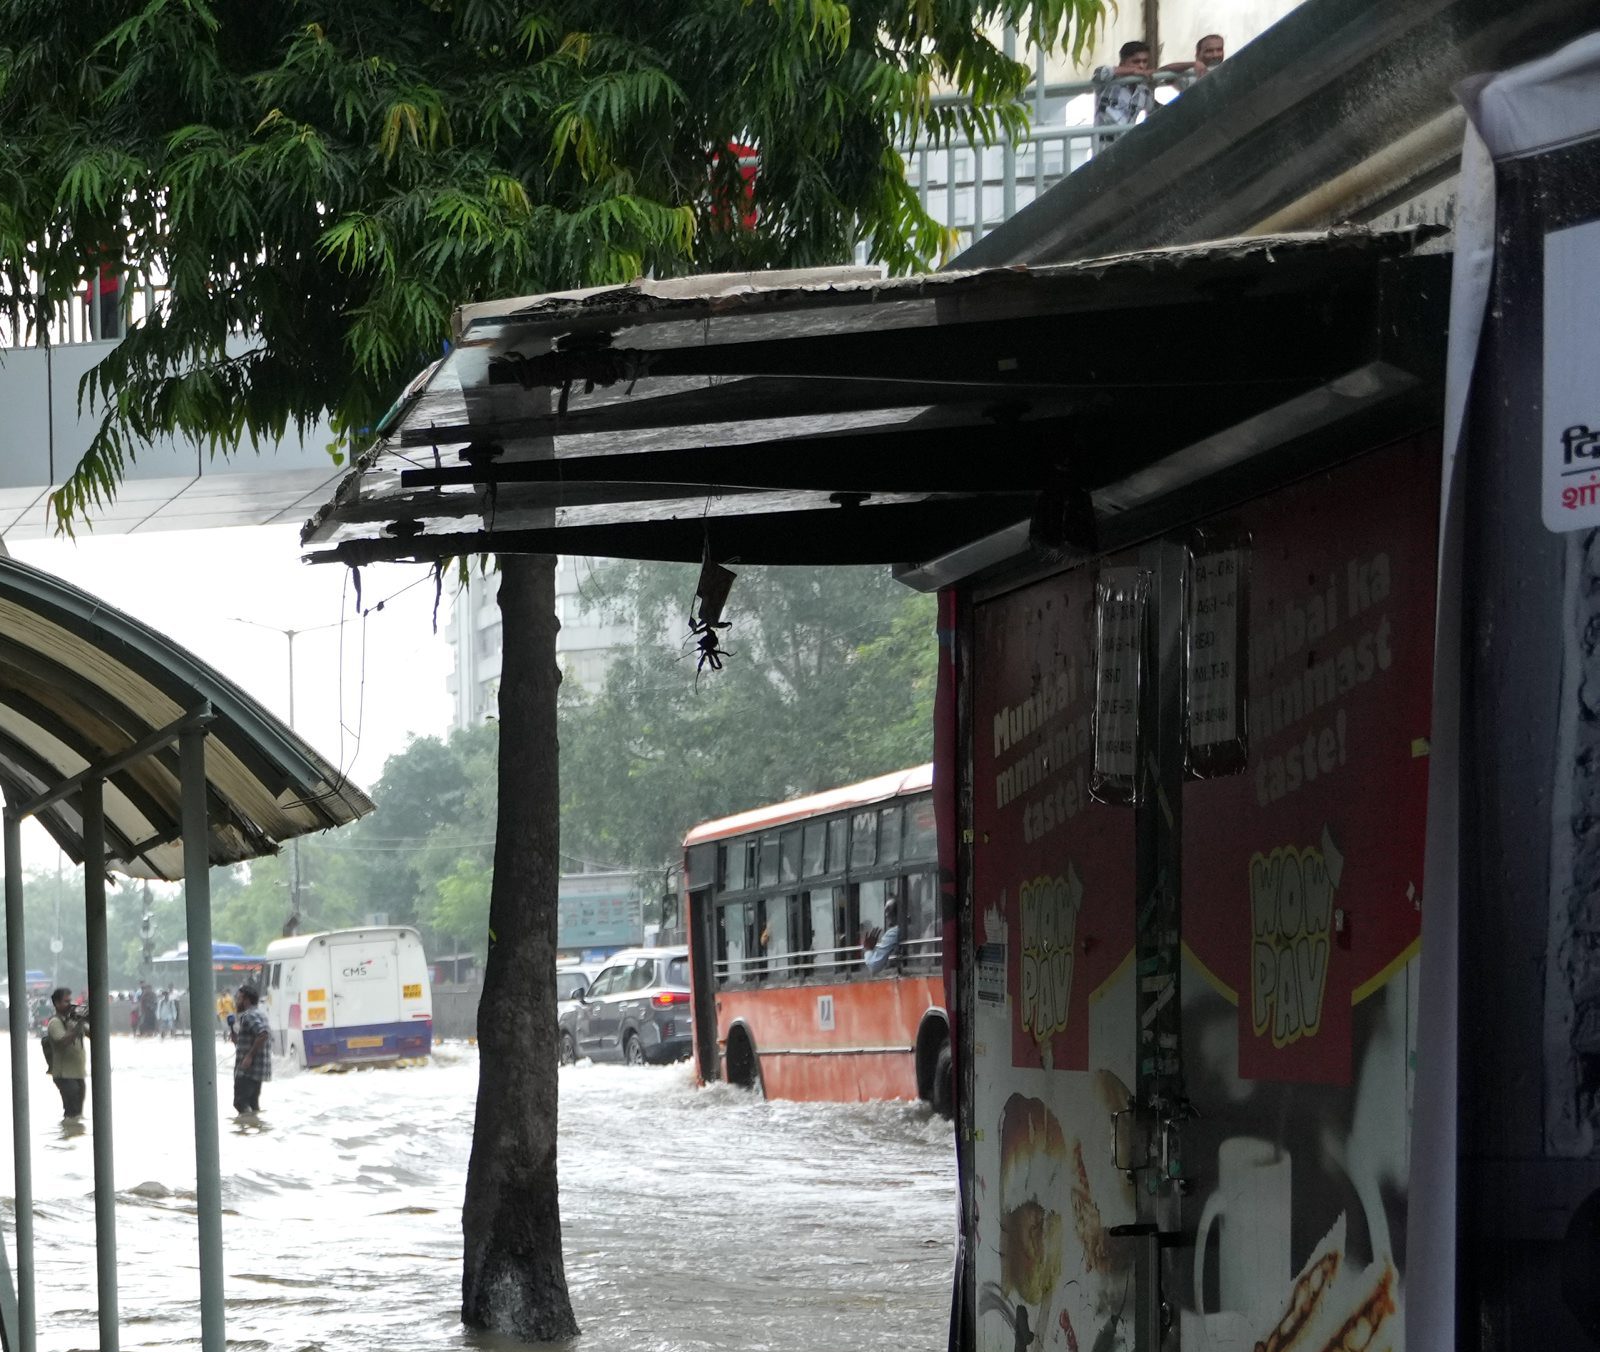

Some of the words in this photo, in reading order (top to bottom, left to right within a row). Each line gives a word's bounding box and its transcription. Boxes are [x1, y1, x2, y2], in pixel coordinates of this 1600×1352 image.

[1347, 552, 1391, 618] ka
[1256, 708, 1347, 807] taste!
[1251, 848, 1333, 941] WOW
[342, 966, 368, 978] CMS
[1021, 950, 1073, 1037] PAV
[1252, 936, 1330, 1043] PAV
